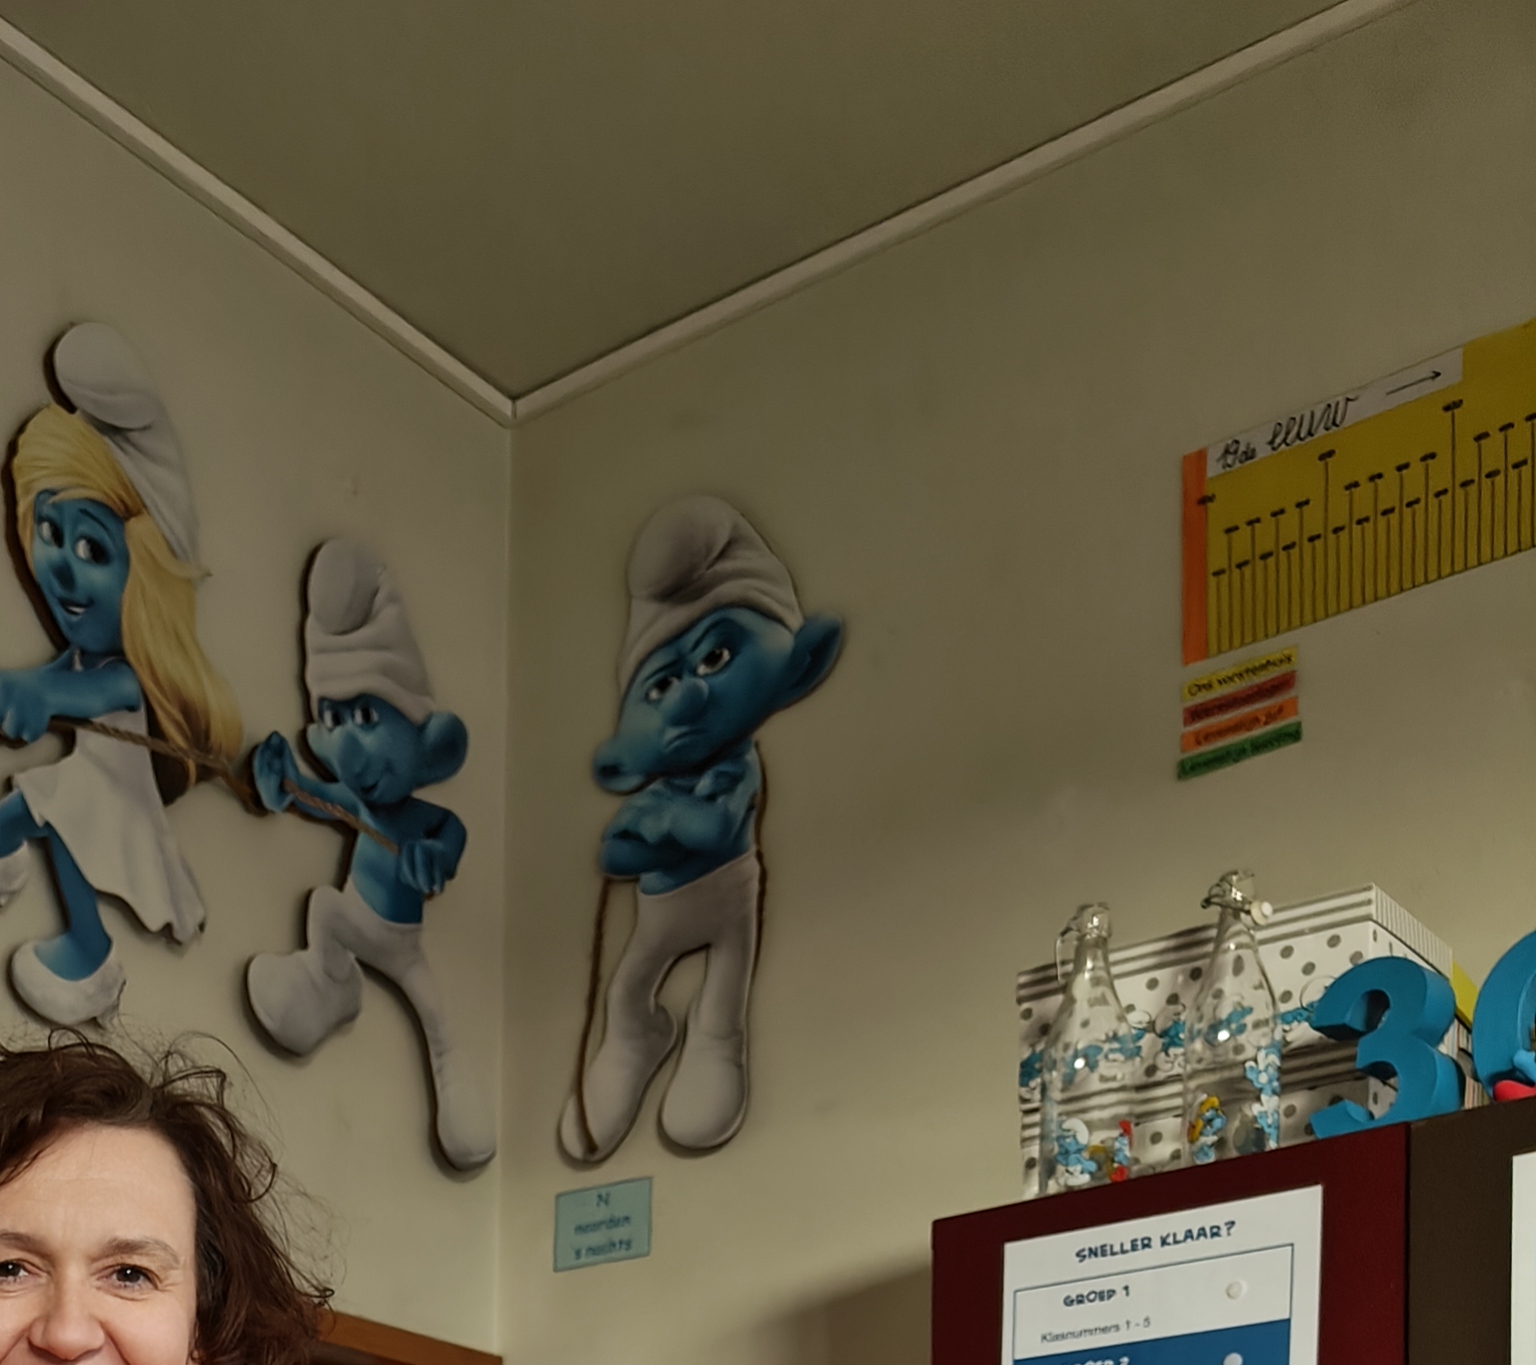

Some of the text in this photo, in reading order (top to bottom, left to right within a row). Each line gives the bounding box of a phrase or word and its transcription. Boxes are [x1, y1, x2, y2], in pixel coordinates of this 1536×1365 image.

[1267, 395, 1359, 450] eeuw
[1075, 1220, 1236, 1263] SNELLER KLAAR?
[1063, 1285, 1131, 1307] GROEP 1
[1040, 1324, 1120, 1344] Klasnummers
[1124, 1319, 1131, 1331] 1
